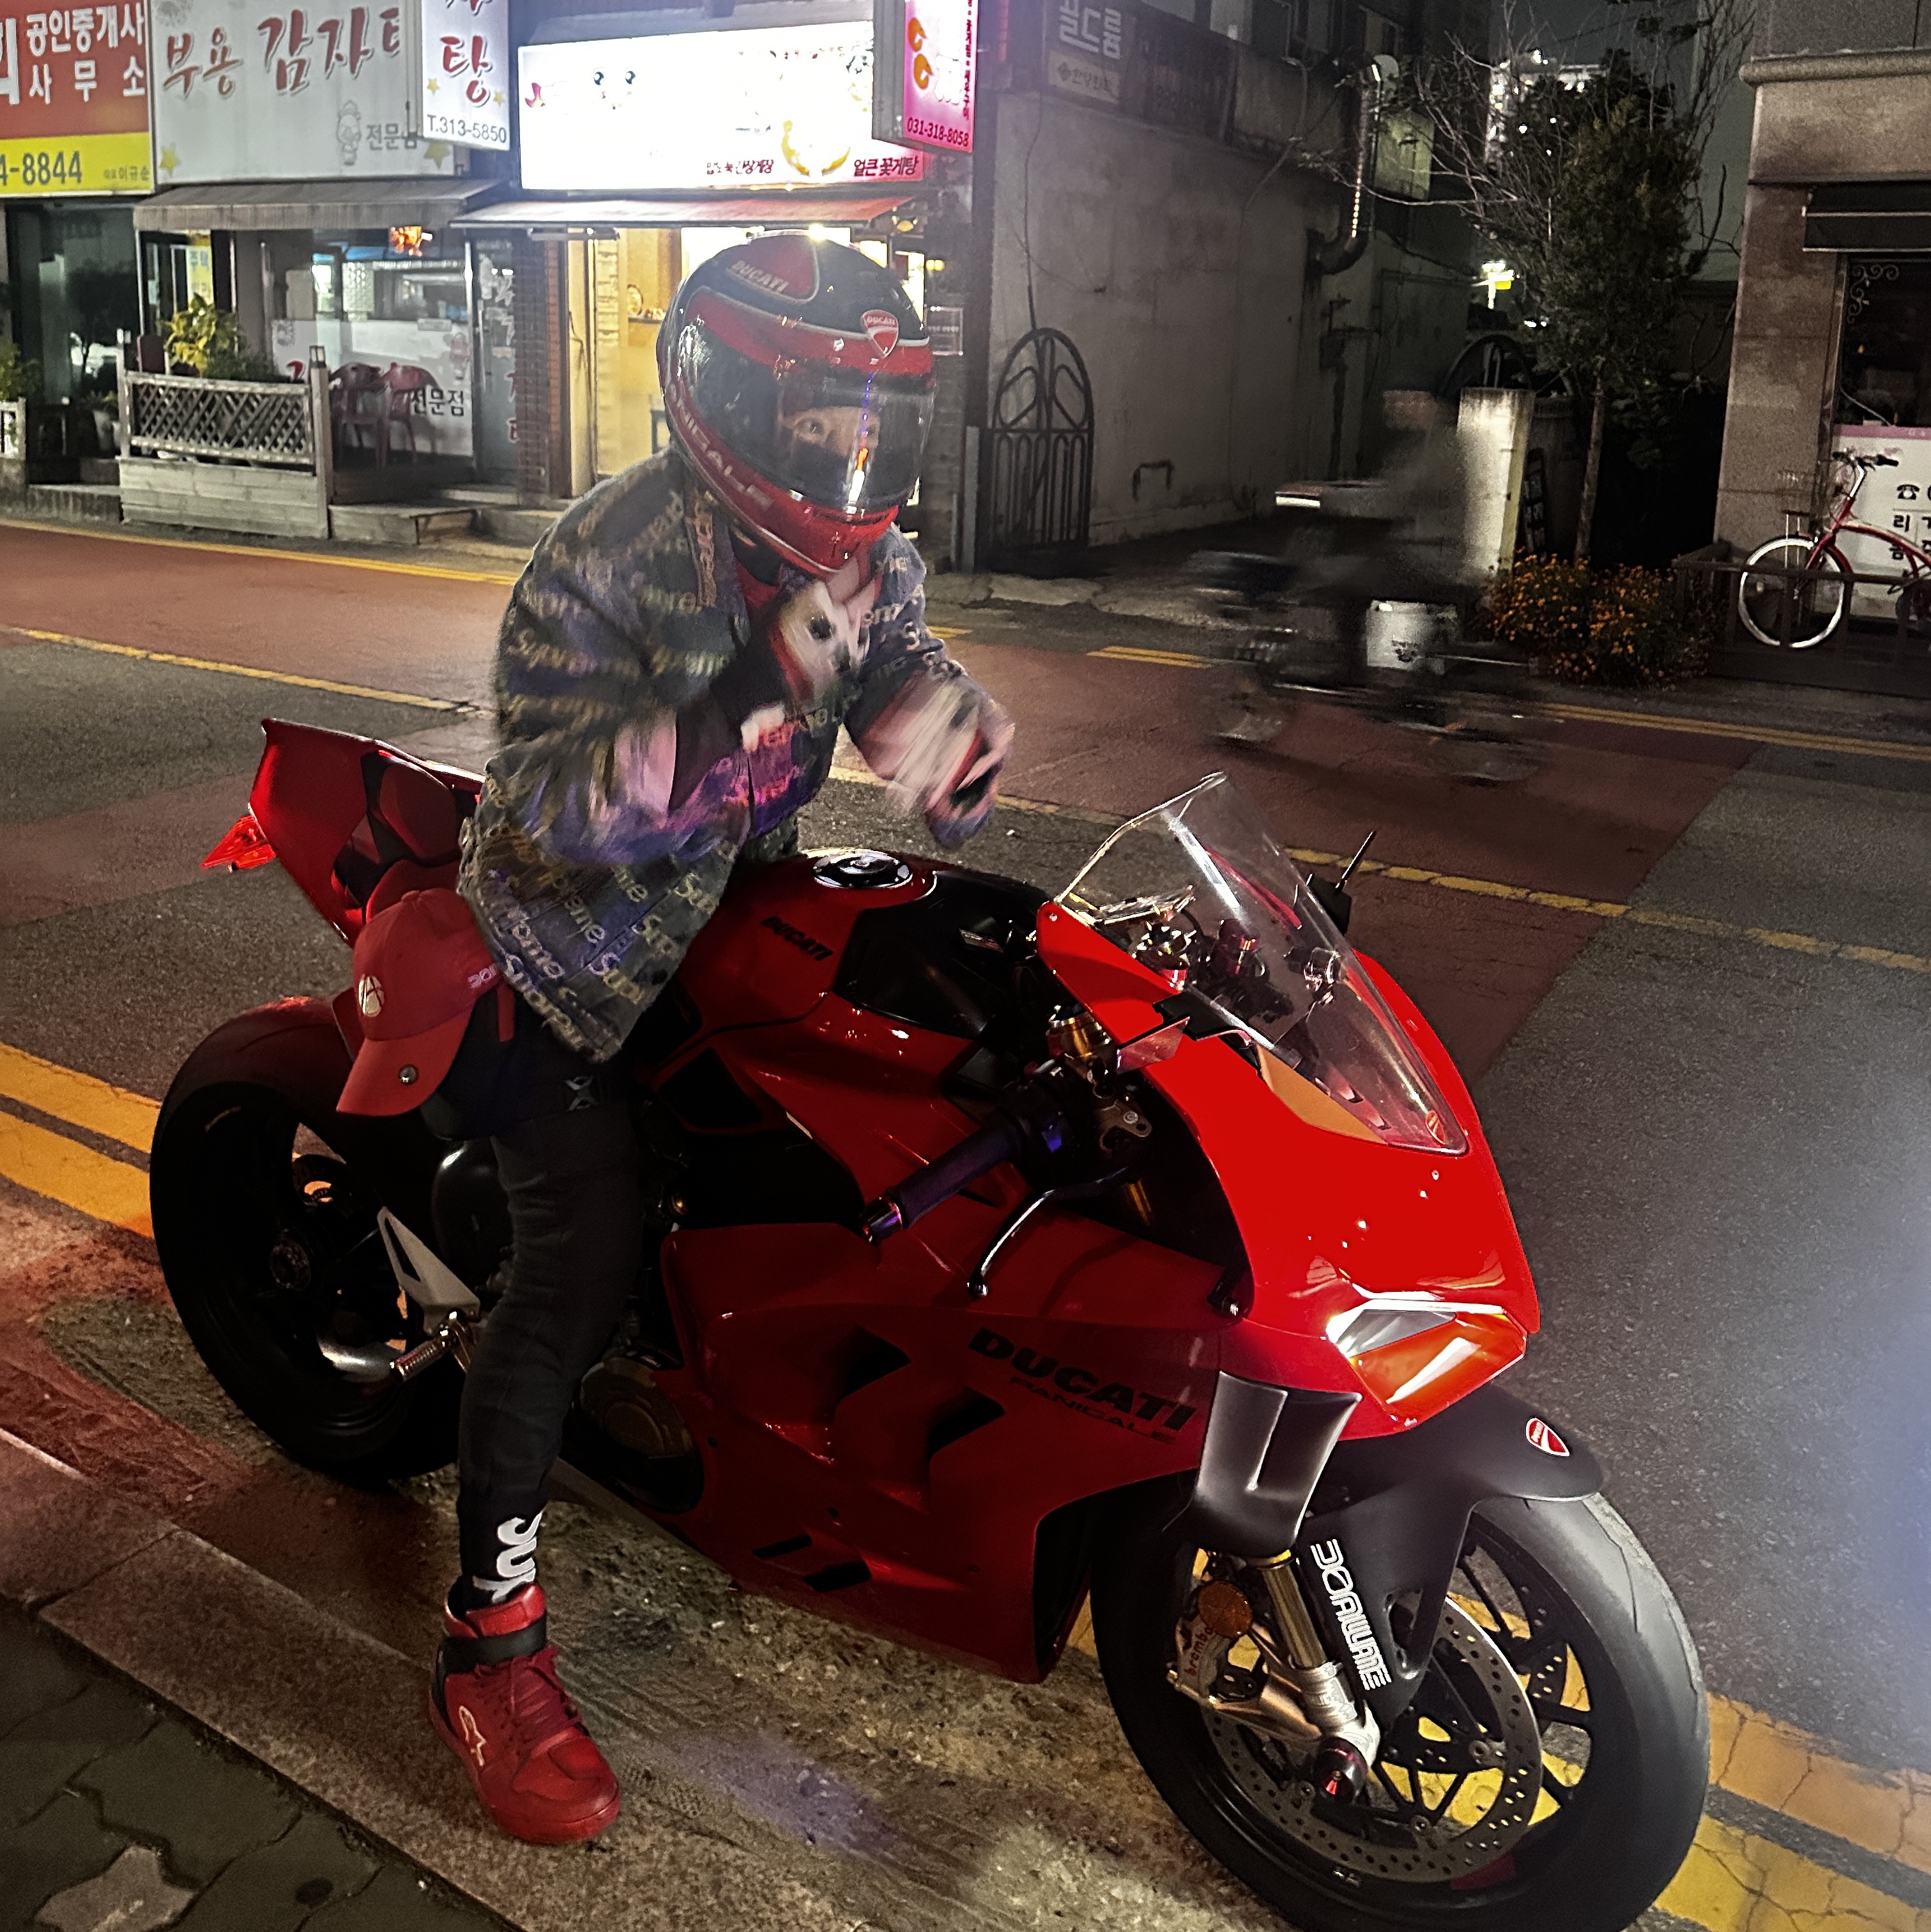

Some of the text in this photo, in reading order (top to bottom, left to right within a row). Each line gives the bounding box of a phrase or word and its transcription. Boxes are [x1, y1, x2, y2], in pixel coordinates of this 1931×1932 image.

[26, 2, 144, 56] 공인중개사
[164, 27, 243, 100] 부용
[427, 113, 507, 144] T.313-5850
[907, 117, 970, 147] 031-318-8058
[854, 156, 919, 177] 얼큰 꽃게탕
[731, 260, 790, 293] DUCATI
[866, 316, 896, 326] DUCATI
[762, 916, 834, 961] DUCATI
[968, 1328, 1197, 1432] DUCATI
